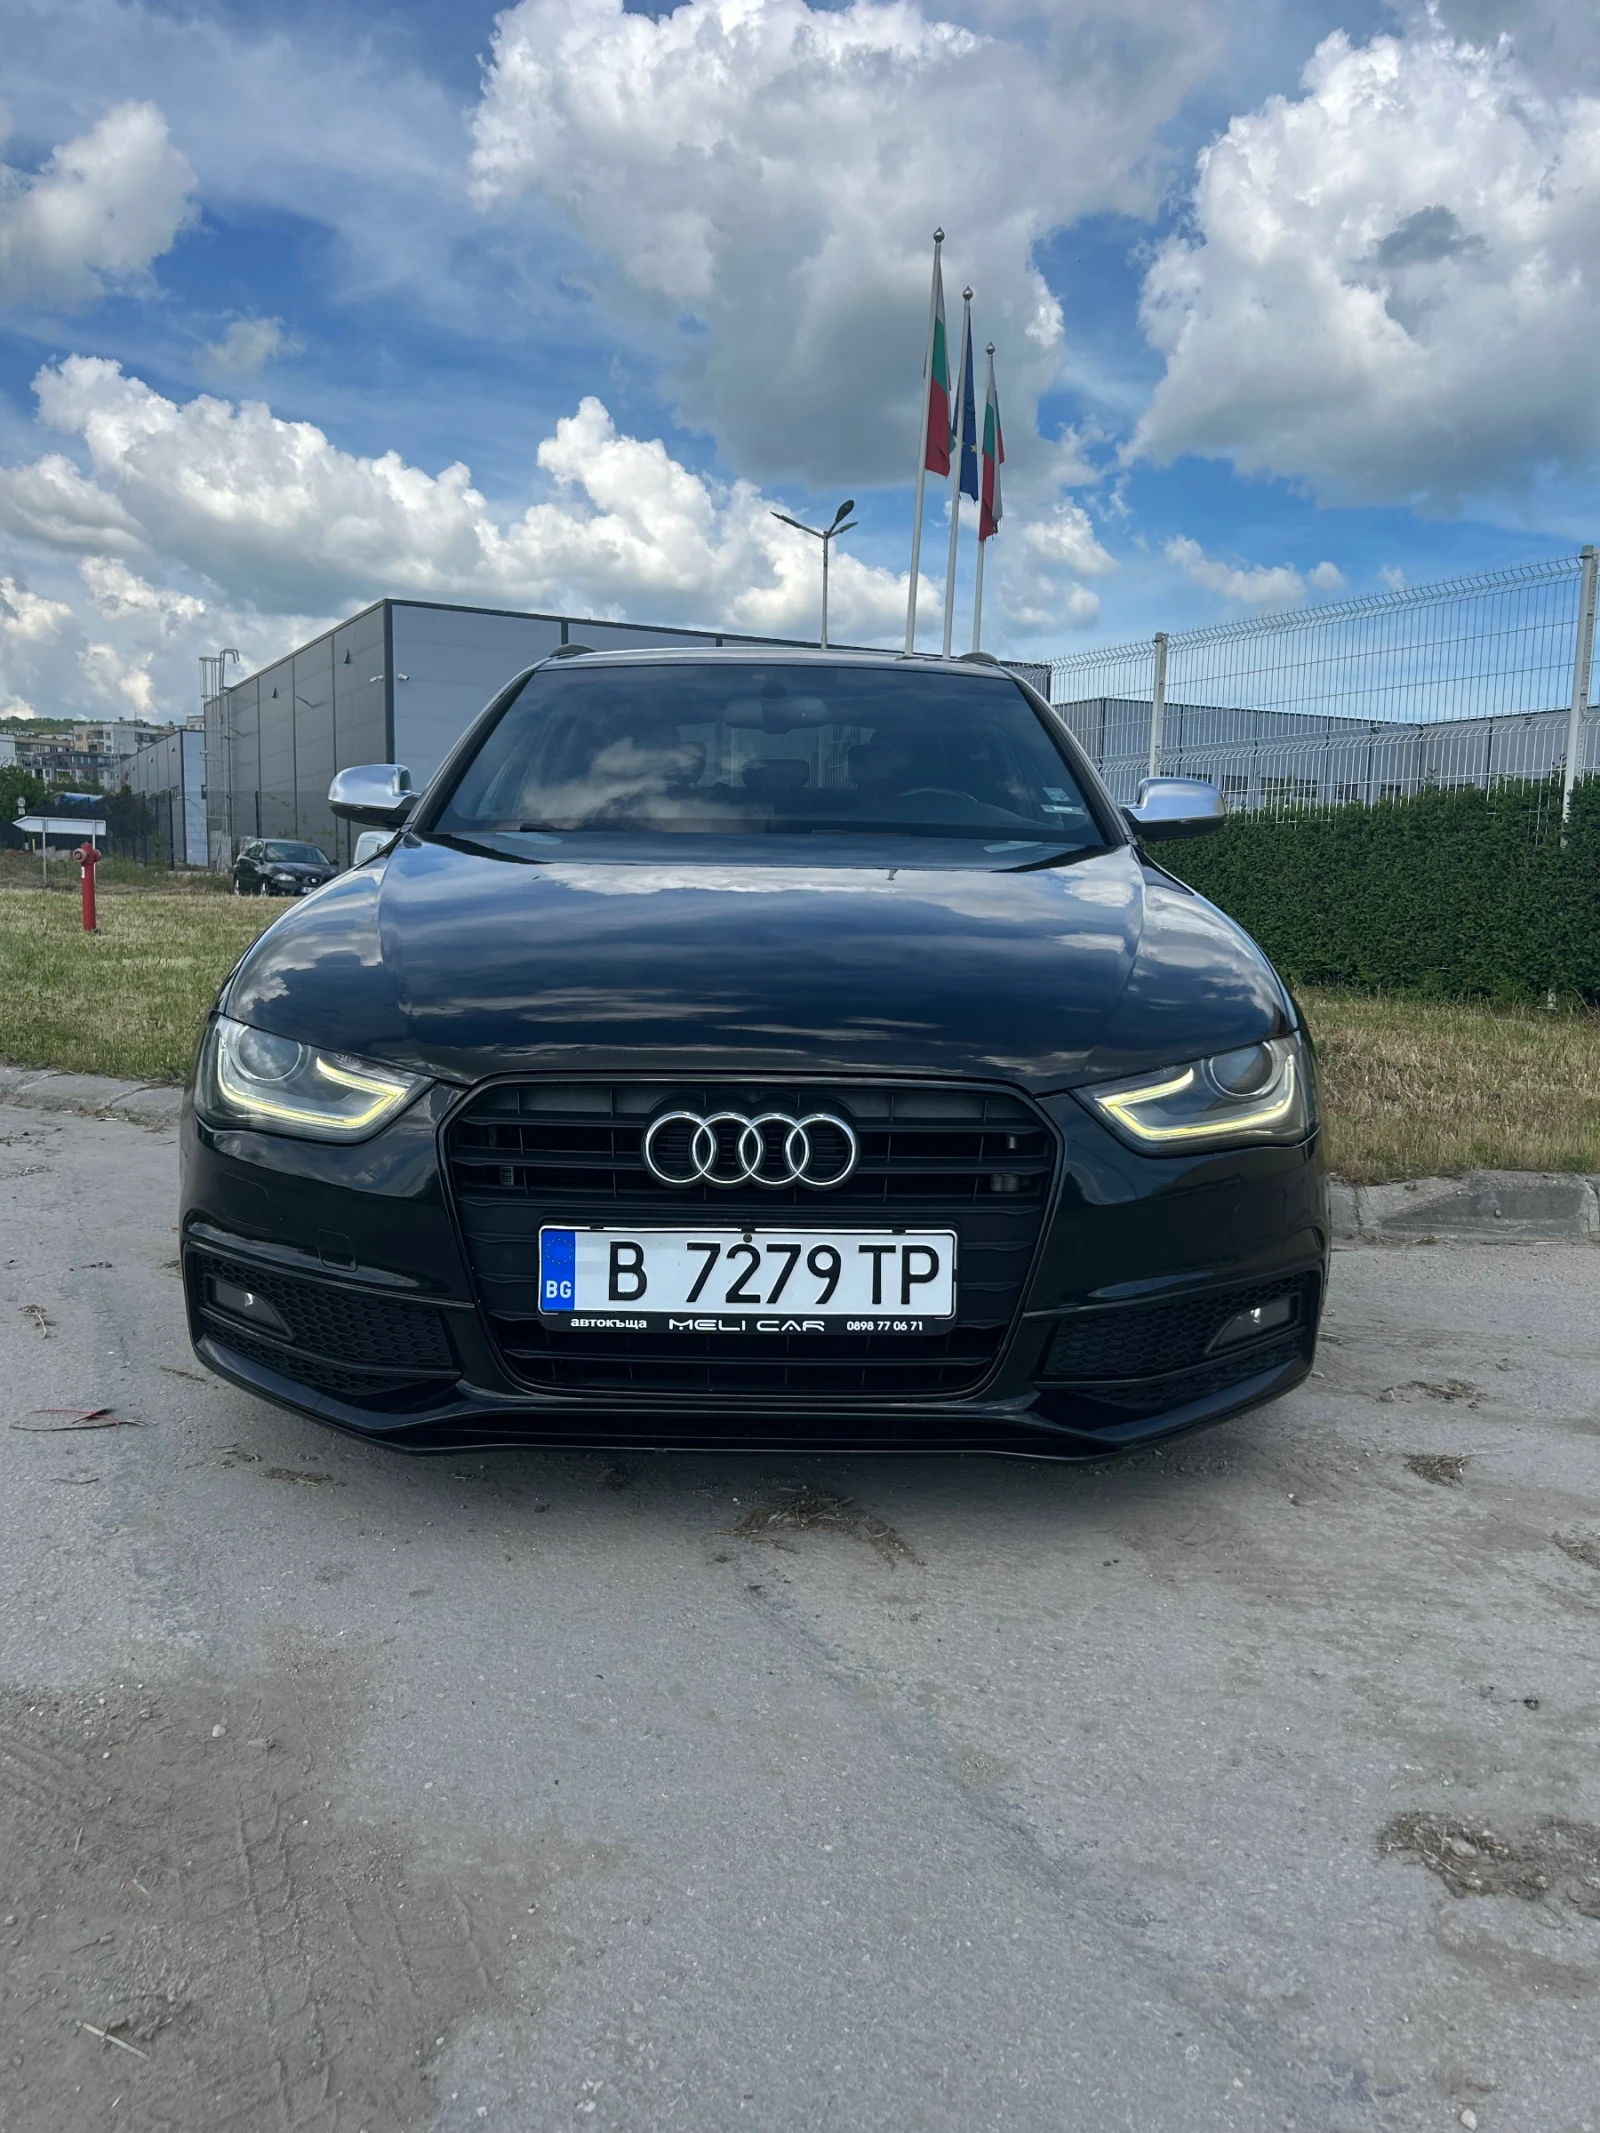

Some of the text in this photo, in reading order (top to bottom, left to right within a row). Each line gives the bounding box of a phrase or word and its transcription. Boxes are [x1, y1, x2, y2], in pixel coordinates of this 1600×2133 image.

[608, 1241, 940, 1305] B 7279 TP
[546, 1280, 572, 1299] BG
[570, 1318, 648, 1330] автокъща
[668, 1318, 825, 1332] MELI CAR
[846, 1320, 923, 1331] 0898 77 06 71
